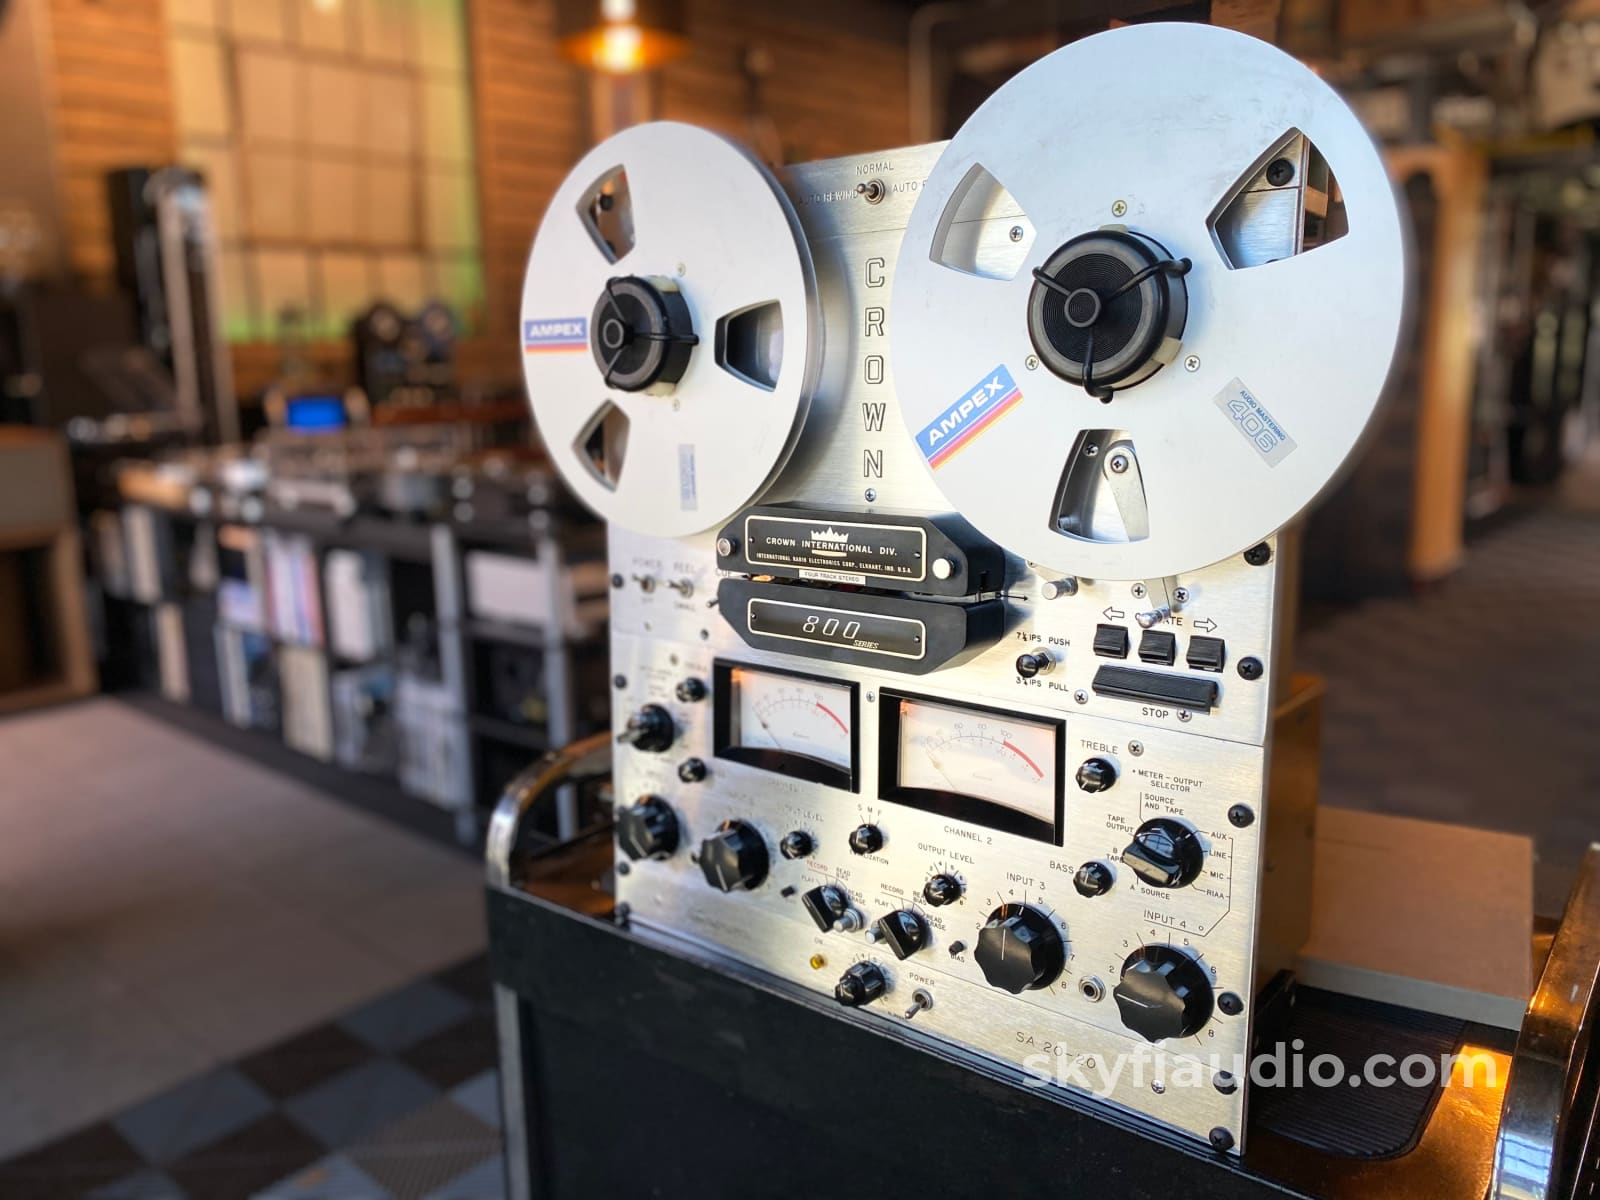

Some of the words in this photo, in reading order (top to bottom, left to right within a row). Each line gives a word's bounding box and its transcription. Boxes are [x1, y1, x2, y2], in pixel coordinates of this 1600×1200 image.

[856, 161, 894, 176] NORMAL
[892, 181, 918, 192] AUTO
[529, 321, 584, 337] AMPEX
[863, 256, 886, 478] CROWN
[929, 375, 1005, 446] AMPEX
[1240, 390, 1257, 408] AUDIO
[1256, 408, 1286, 441] MASTERING
[1227, 400, 1278, 453] 406
[766, 536, 796, 547] CROWN
[801, 540, 873, 554] INTERNATIONAL
[879, 546, 898, 556] DIV.
[756, 552, 791, 561] INTERNATIONAL
[808, 558, 840, 567] ELECTRONICS
[838, 575, 860, 583] STEREO
[803, 616, 860, 639] 800
[853, 640, 880, 649] SERIES
[1029, 634, 1042, 642] IPS
[1048, 636, 1071, 647] PUSH
[1029, 679, 1042, 687] IPS
[1048, 682, 1068, 692] PULL
[1142, 707, 1169, 718] STOP
[1080, 739, 1119, 754] TREBLE
[1138, 770, 1164, 780] METER
[1173, 777, 1203, 788] OUTPUT
[1150, 780, 1191, 793] SELECTOR
[1144, 793, 1175, 805] SOURCE
[1144, 802, 1160, 810] AND
[1166, 806, 1184, 816] TAPE
[1108, 814, 1126, 824] TAPE
[1106, 822, 1134, 833] OUTPUT
[944, 825, 982, 843] CHANNEL
[987, 836, 992, 845] 2
[1210, 831, 1227, 840] AUX
[918, 842, 946, 856] OUTPUT
[950, 851, 975, 865] LEVEL
[1106, 854, 1124, 863] TAPE
[1209, 850, 1227, 859] LINE
[806, 860, 828, 871] RECORD
[1050, 860, 1074, 874] BASS
[801, 874, 814, 882] PLAY
[1006, 872, 1034, 887] INPUT
[1039, 881, 1046, 890] 3
[1210, 872, 1224, 880] MIC
[881, 883, 904, 895] RECORD
[1008, 888, 1014, 896] 4
[1141, 888, 1170, 899] SOURCE
[1206, 889, 1225, 899] RIAA
[874, 898, 888, 907] PLAY
[986, 898, 992, 906] 3
[1038, 897, 1043, 905] 5
[1143, 909, 1175, 926] INPUT
[1179, 920, 1187, 928] 4
[975, 922, 981, 930] 2
[1061, 922, 1066, 930] 6
[1123, 940, 1129, 948] 3
[1183, 938, 1189, 946] 5
[1109, 965, 1115, 973] 2
[1211, 966, 1217, 974] 6
[909, 972, 935, 986] POWER
[1061, 981, 1067, 989] 8
[1208, 1029, 1215, 1038] 8
[1016, 1031, 1035, 1048] SA
